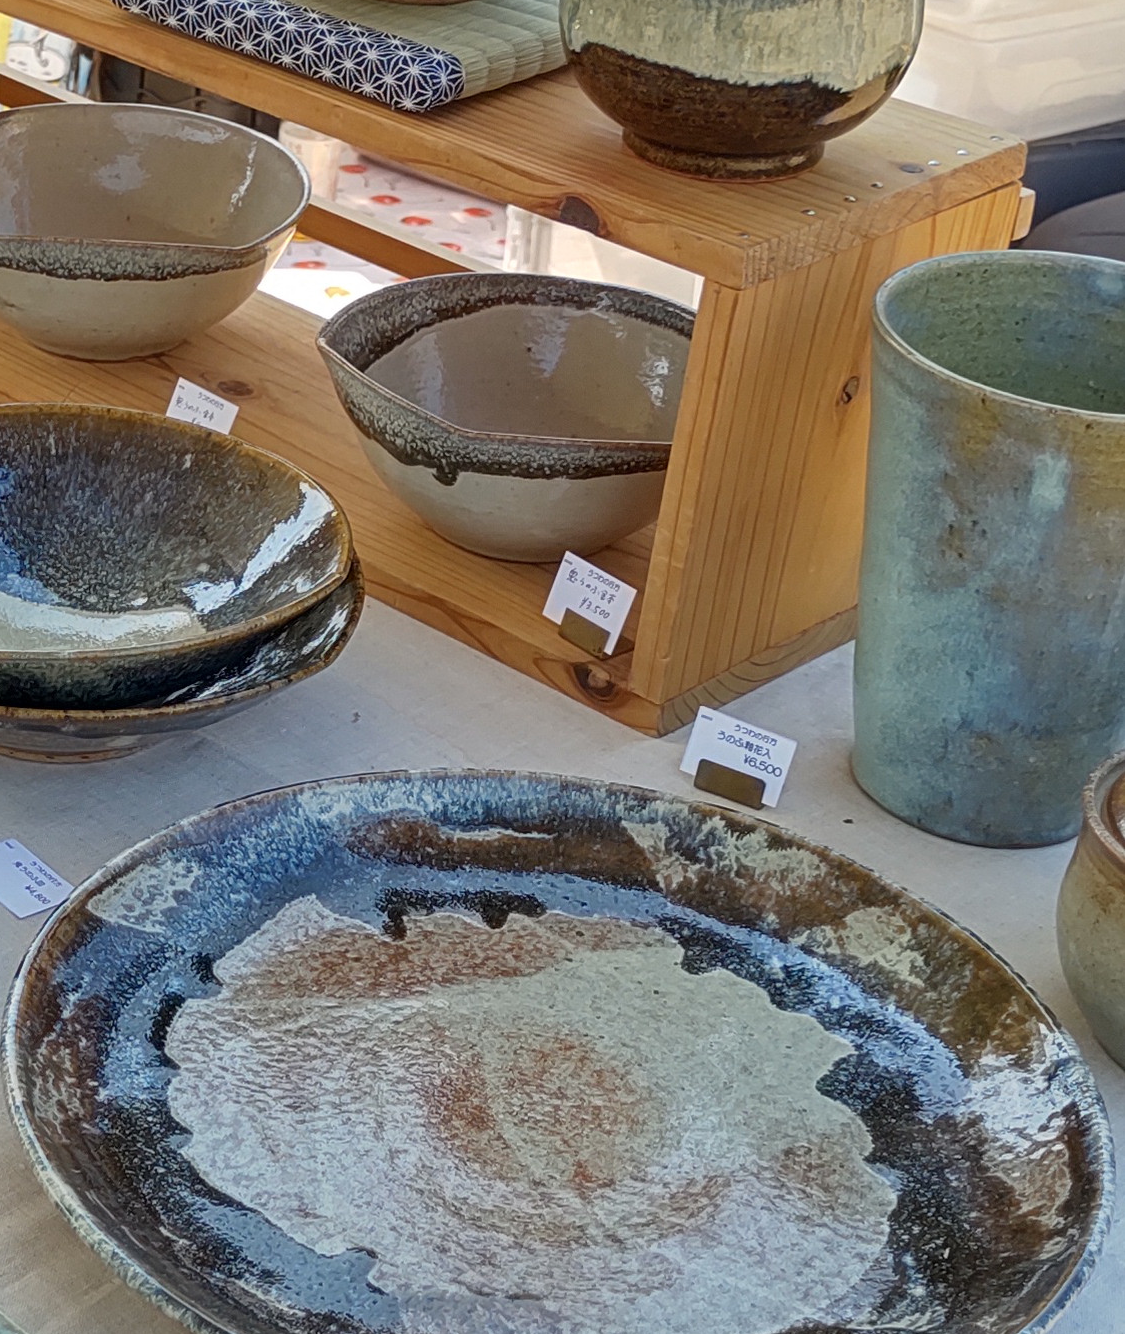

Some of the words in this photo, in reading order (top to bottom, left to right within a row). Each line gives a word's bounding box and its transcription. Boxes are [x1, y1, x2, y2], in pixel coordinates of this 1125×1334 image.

[734, 724, 778, 747] うつわの行方
[743, 753, 783, 778] ¥6,500
